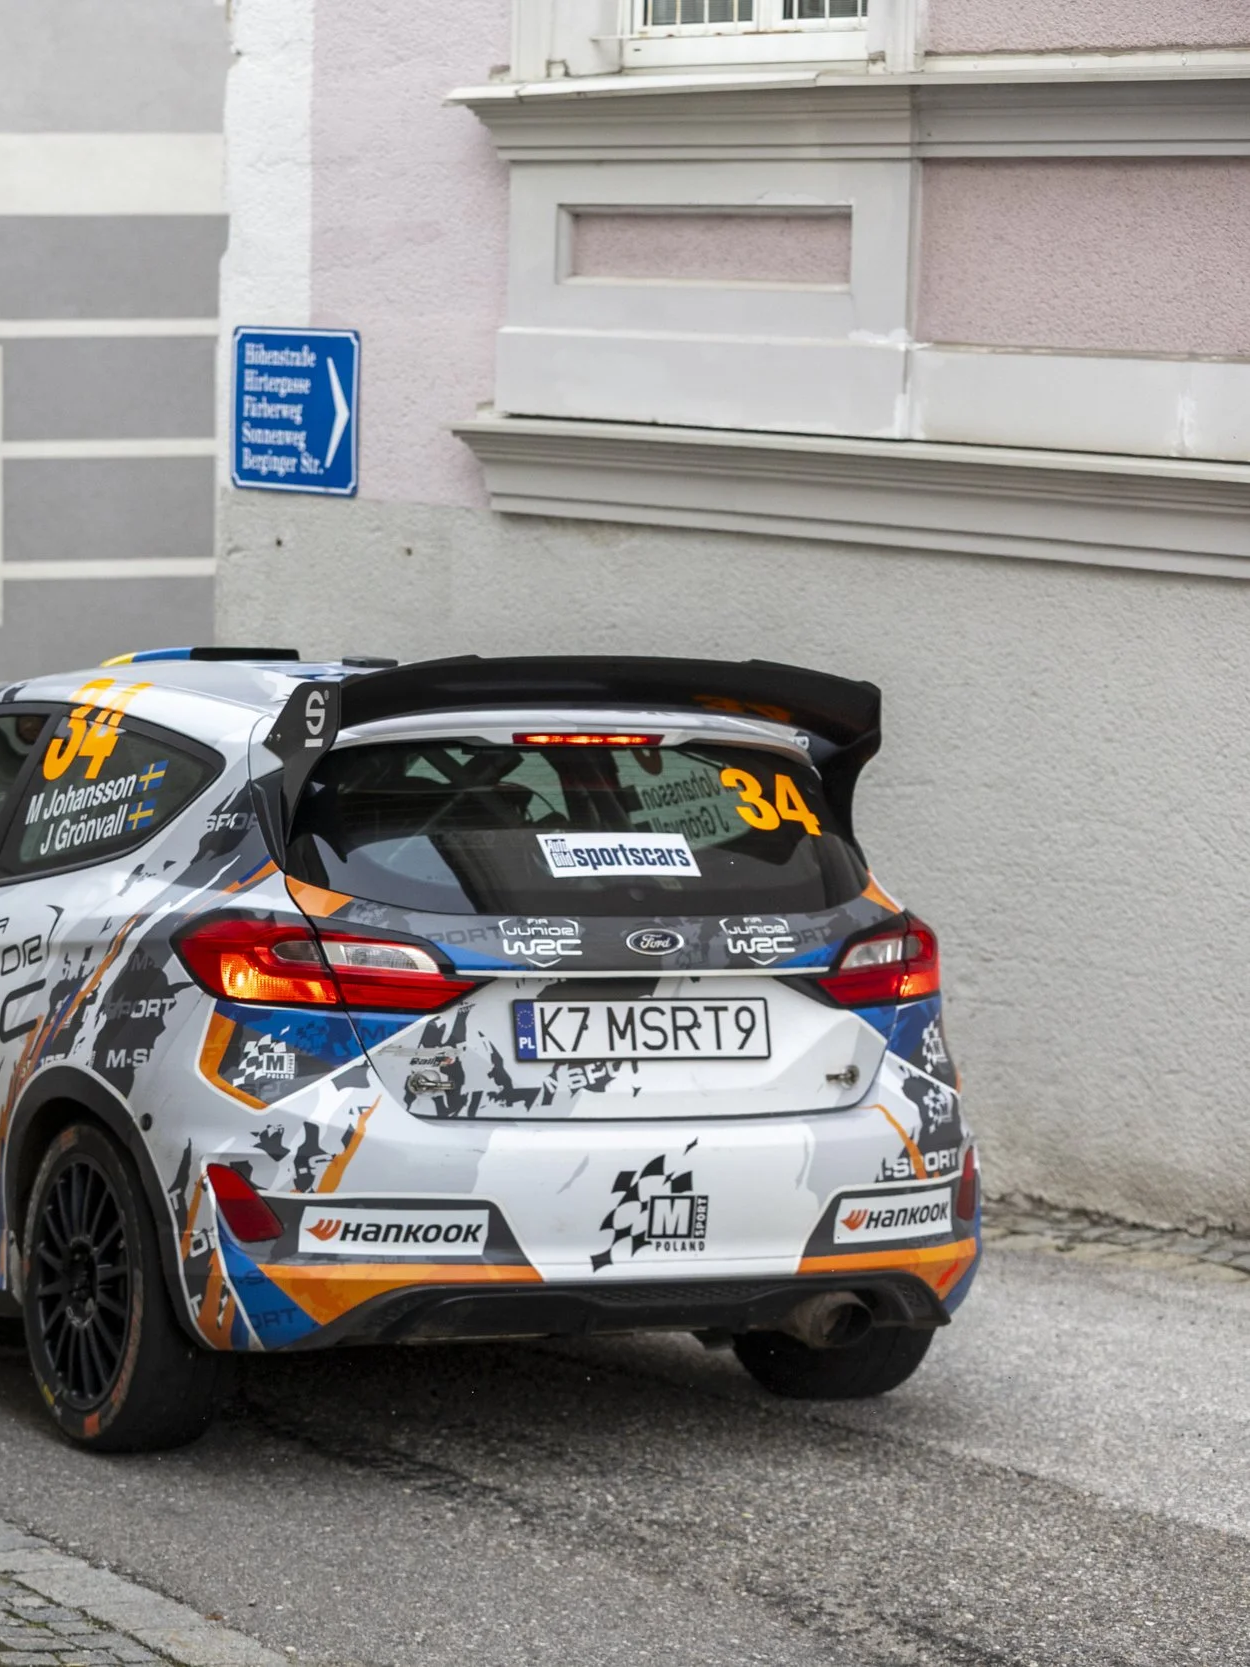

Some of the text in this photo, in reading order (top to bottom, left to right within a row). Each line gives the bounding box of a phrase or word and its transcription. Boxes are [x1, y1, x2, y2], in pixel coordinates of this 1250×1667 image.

[245, 343, 317, 368] Höhenstraße
[242, 422, 306, 451] Sonnenweg
[300, 453, 324, 475] Str.
[43, 678, 154, 780] 34
[25, 774, 137, 825] M Johansson
[720, 768, 822, 836] 34
[40, 803, 128, 855] J Grönvall
[573, 844, 691, 870] sportscars
[506, 927, 574, 936] JUNIOR
[640, 933, 672, 949] Ford
[728, 925, 785, 935] JUNIOR
[503, 939, 583, 955] WRC
[727, 937, 795, 954] WRC
[519, 1006, 756, 1052] PL K7 MSRT9
[266, 1055, 285, 1071] M
[652, 1199, 690, 1234] M
[695, 1198, 707, 1236] SPORT
[655, 1241, 705, 1251] POLAND
